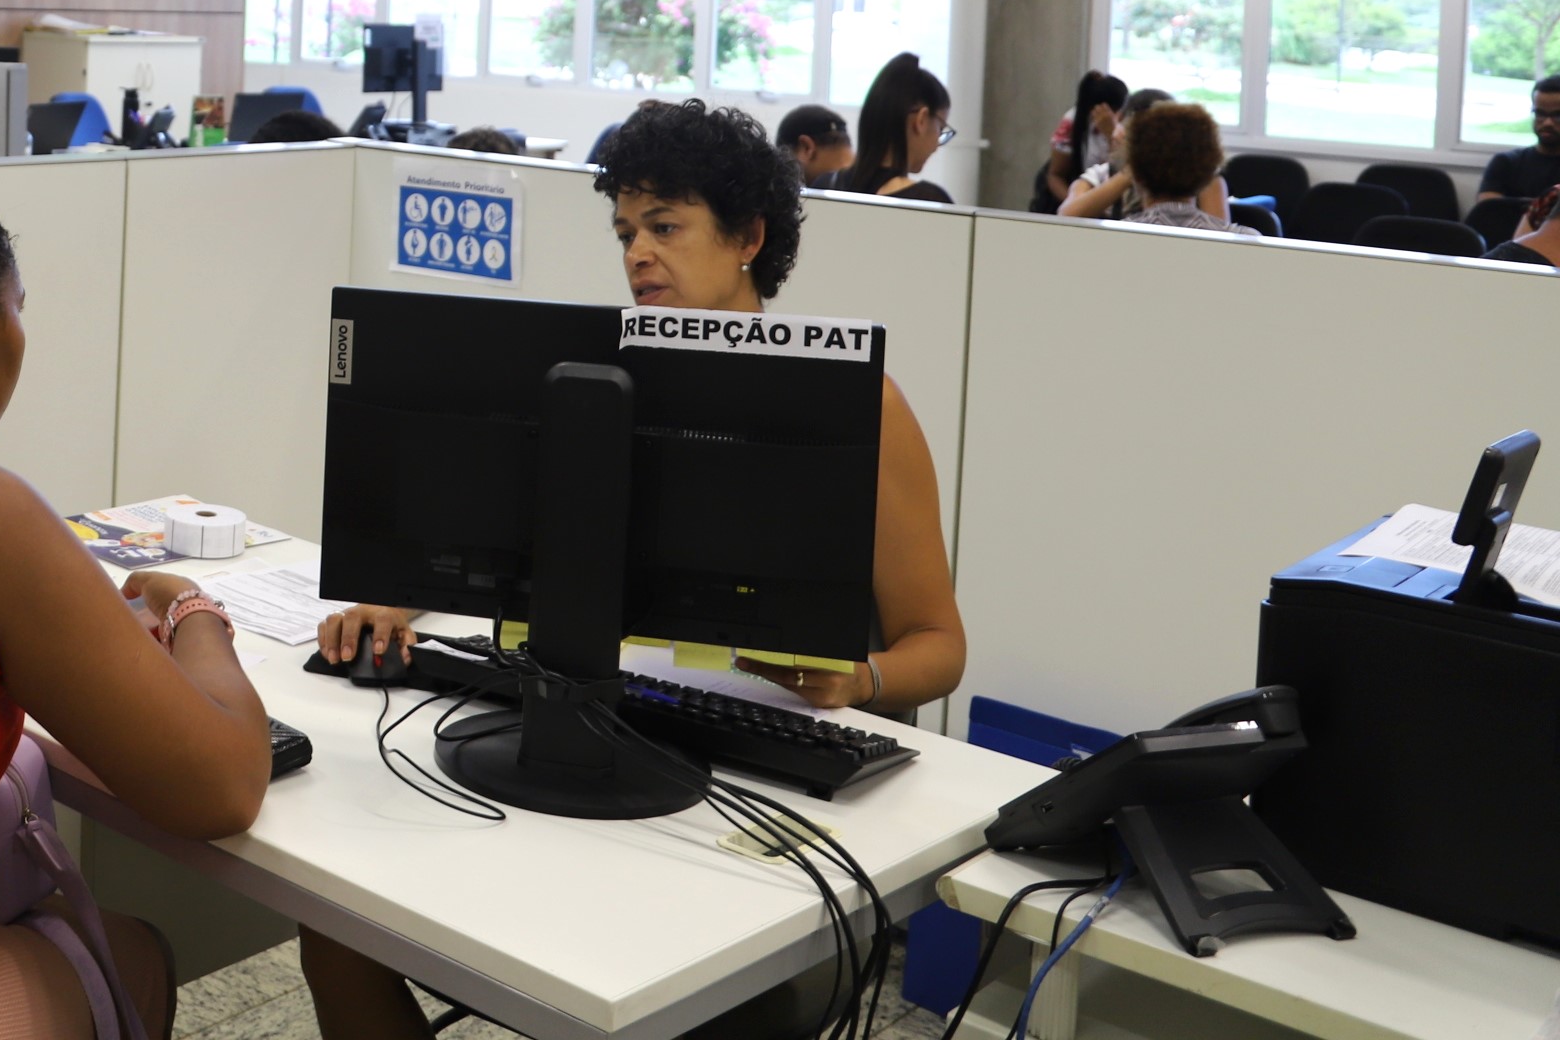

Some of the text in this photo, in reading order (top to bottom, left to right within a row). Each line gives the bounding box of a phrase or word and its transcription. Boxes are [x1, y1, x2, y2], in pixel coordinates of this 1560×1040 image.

[406, 175, 460, 189] Atendimento
[623, 315, 869, 351] RECEPÇÃO PAT
[334, 325, 348, 379] Lenovo
